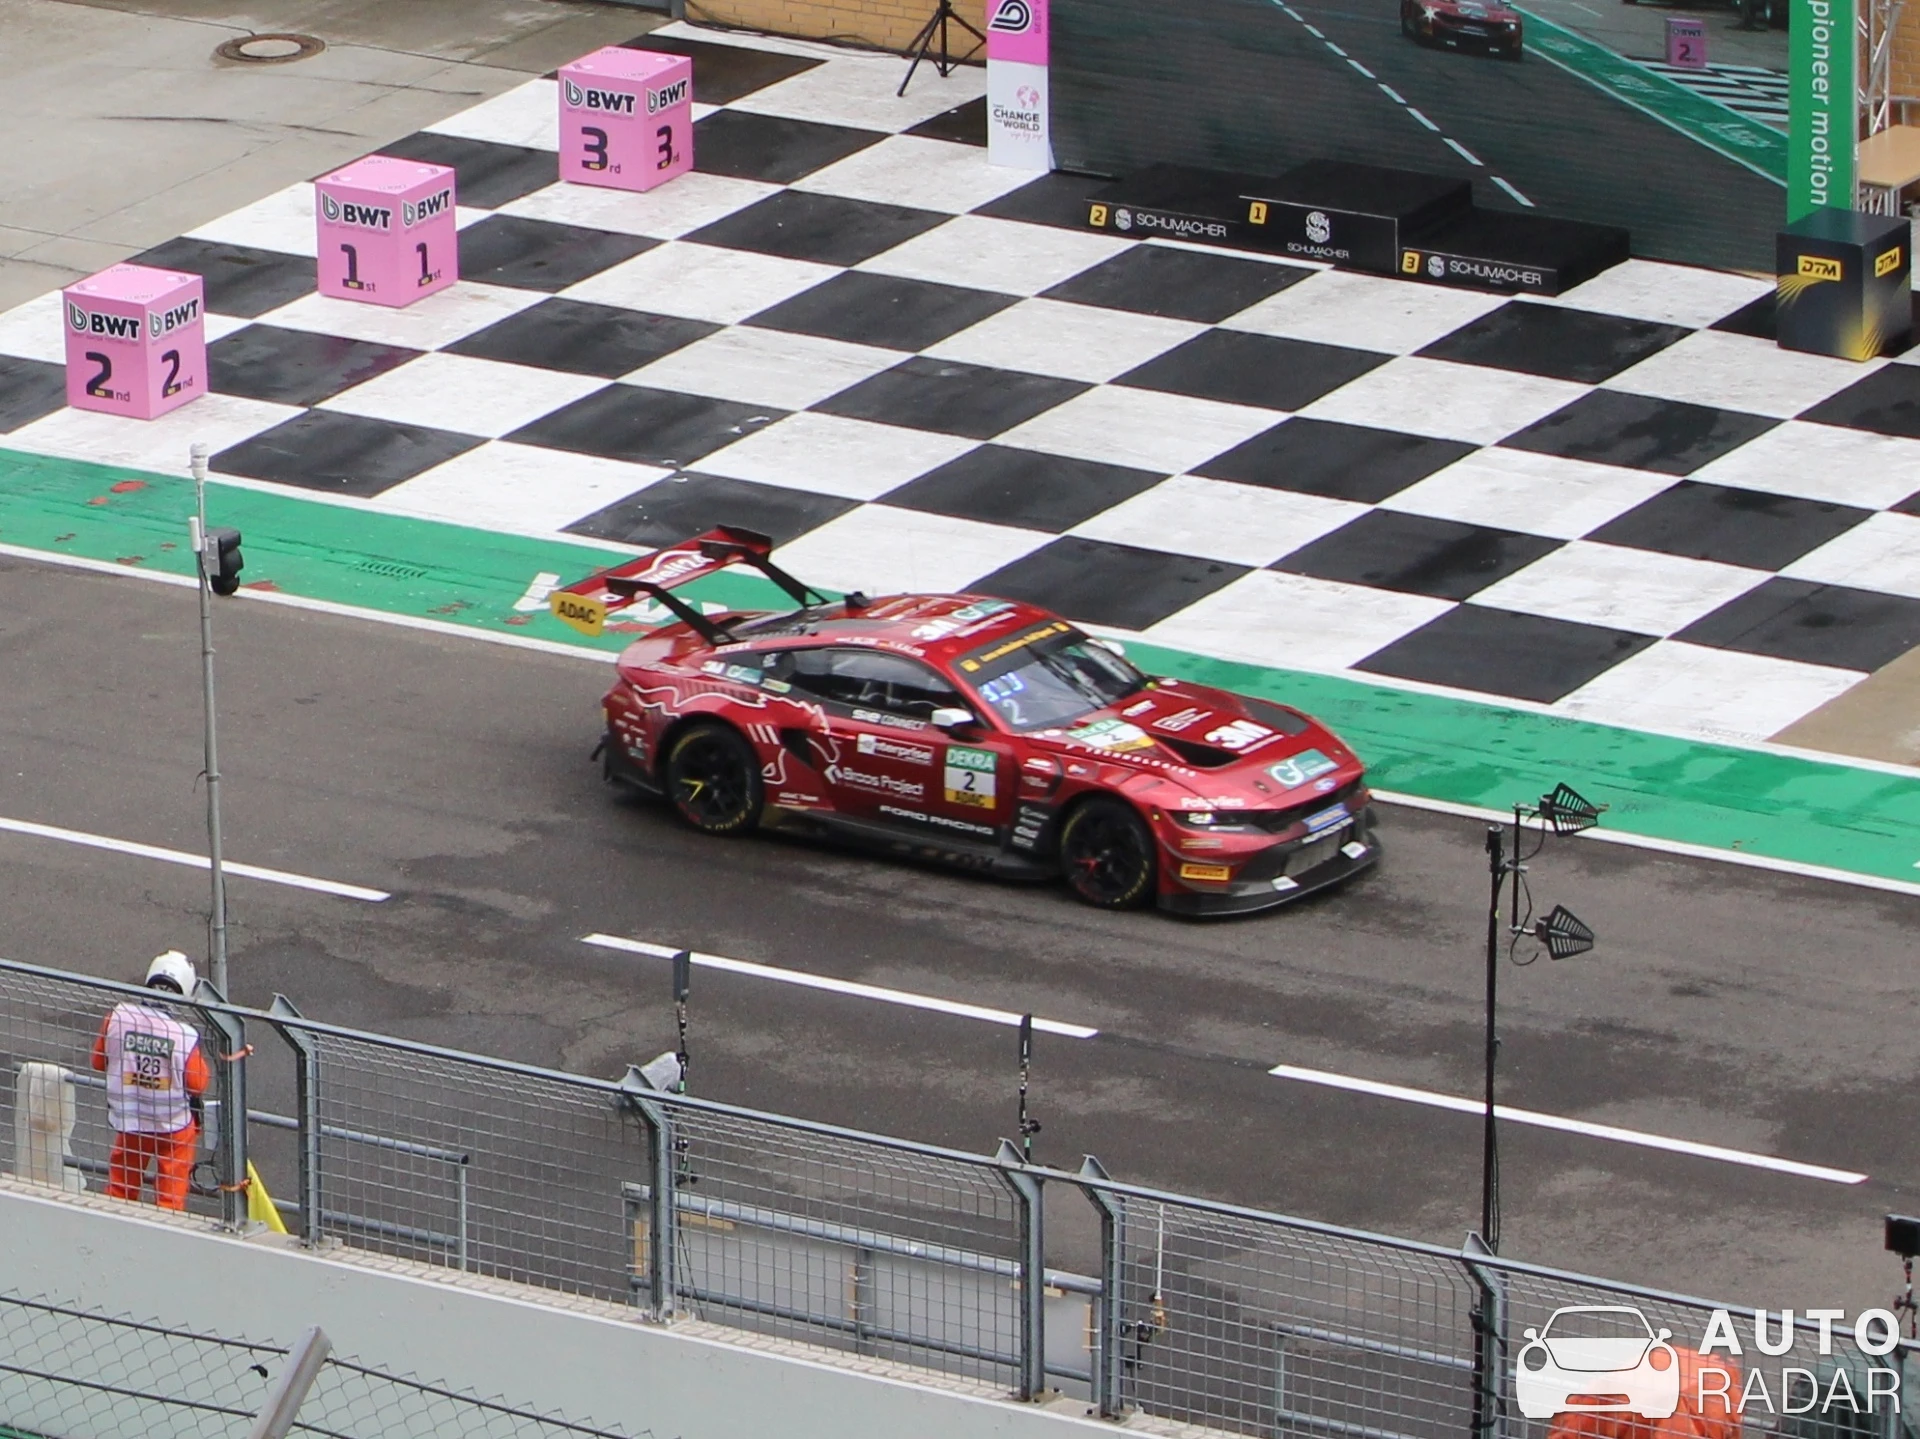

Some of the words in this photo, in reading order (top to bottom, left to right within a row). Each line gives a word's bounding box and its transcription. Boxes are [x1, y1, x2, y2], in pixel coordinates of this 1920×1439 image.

[1807, 0, 1835, 105] pioneer
[587, 90, 635, 114] BWT
[659, 80, 688, 108] BWT
[993, 108, 1040, 122] CHANGE
[1003, 119, 1041, 132] WORLD
[1810, 111, 1834, 206] motion
[343, 203, 391, 229] BWT
[417, 189, 451, 220] BWT
[1136, 212, 1227, 238] SCHUMACHER
[1287, 241, 1350, 260] SCHUMACHER
[1877, 251, 1898, 273] DTM
[1449, 260, 1542, 286] SCHUMACHER
[1801, 260, 1838, 277] DTM
[91, 313, 140, 339] BWT
[165, 299, 199, 331] BWT
[556, 600, 597, 624] ADAC
[1002, 698, 1028, 725] 2
[946, 748, 996, 772] DEKRA
[880, 774, 924, 796] Project
[963, 771, 976, 792] 2
[126, 1034, 170, 1057] DEKRA
